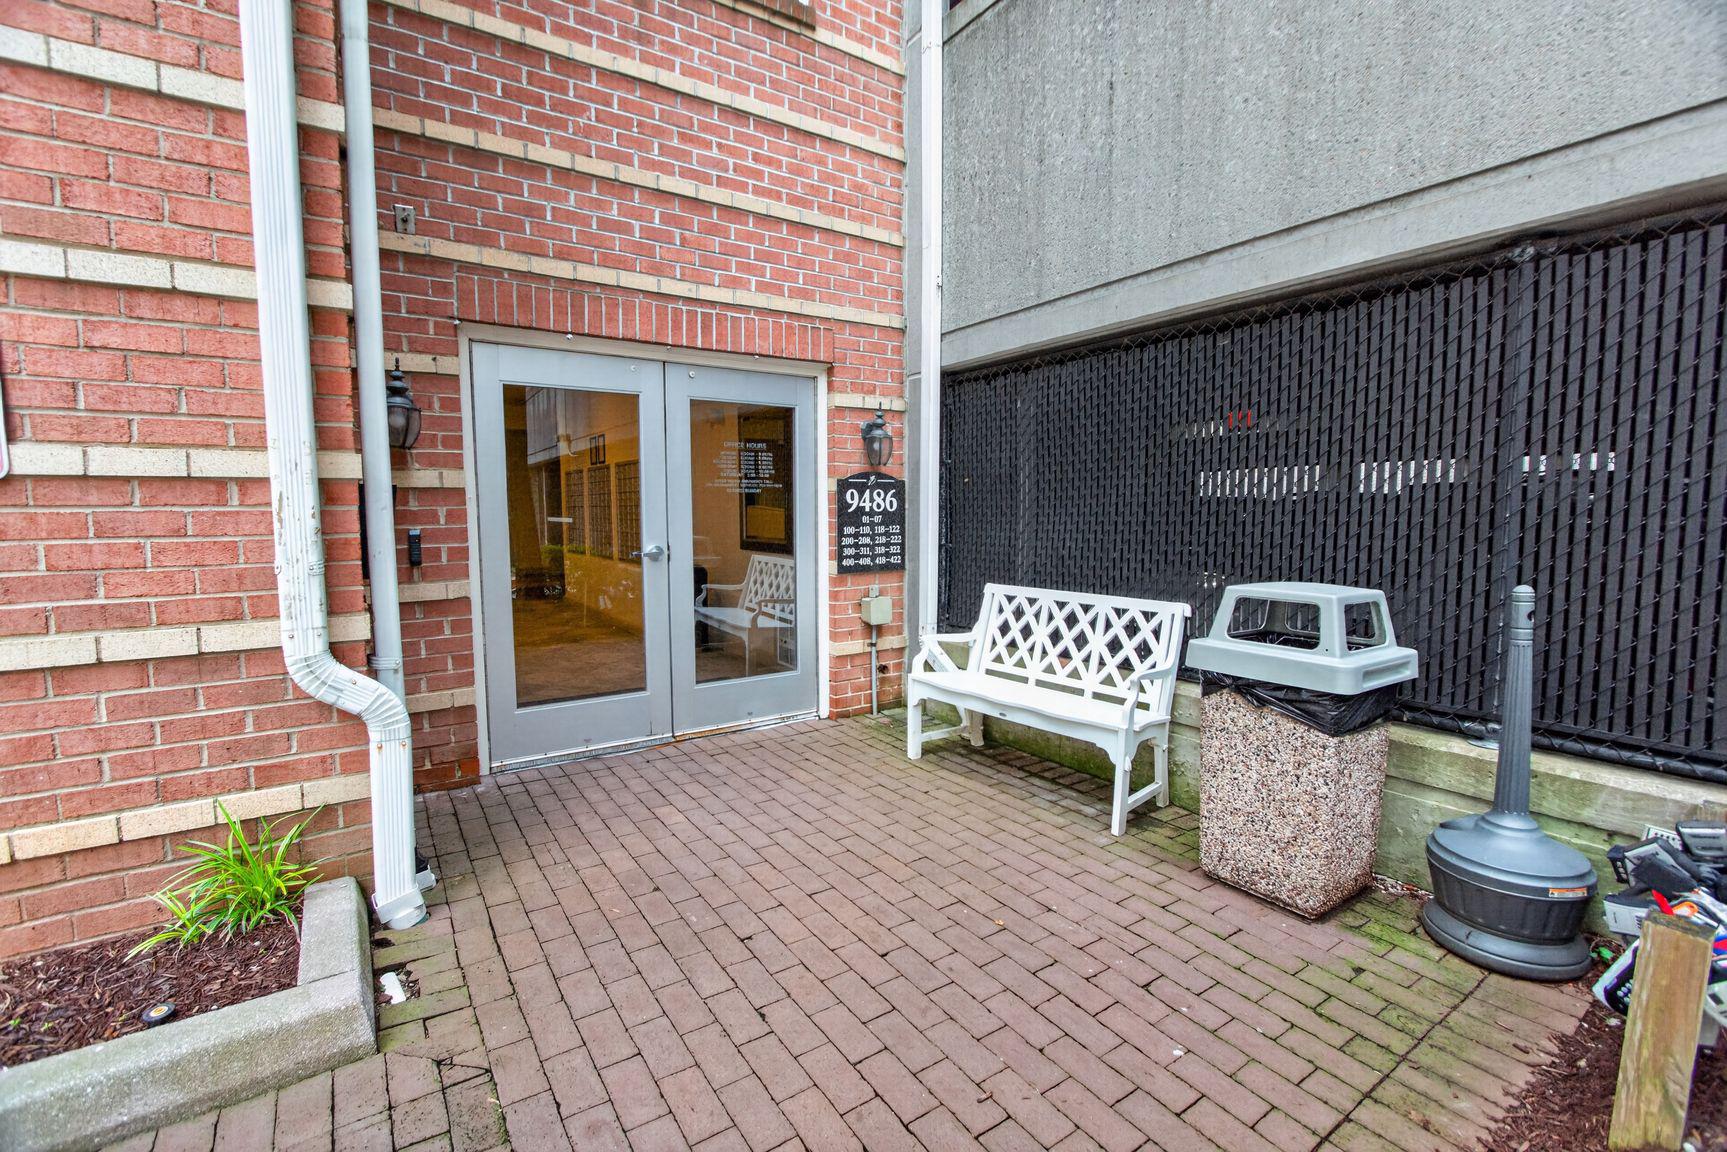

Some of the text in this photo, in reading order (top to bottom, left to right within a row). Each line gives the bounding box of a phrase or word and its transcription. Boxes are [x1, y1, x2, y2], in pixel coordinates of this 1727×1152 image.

[846, 489, 898, 512] 9486
[843, 525, 900, 535] 100-110, 118-122
[843, 547, 872, 556] 300-311,
[875, 556, 901, 564] 418-422
